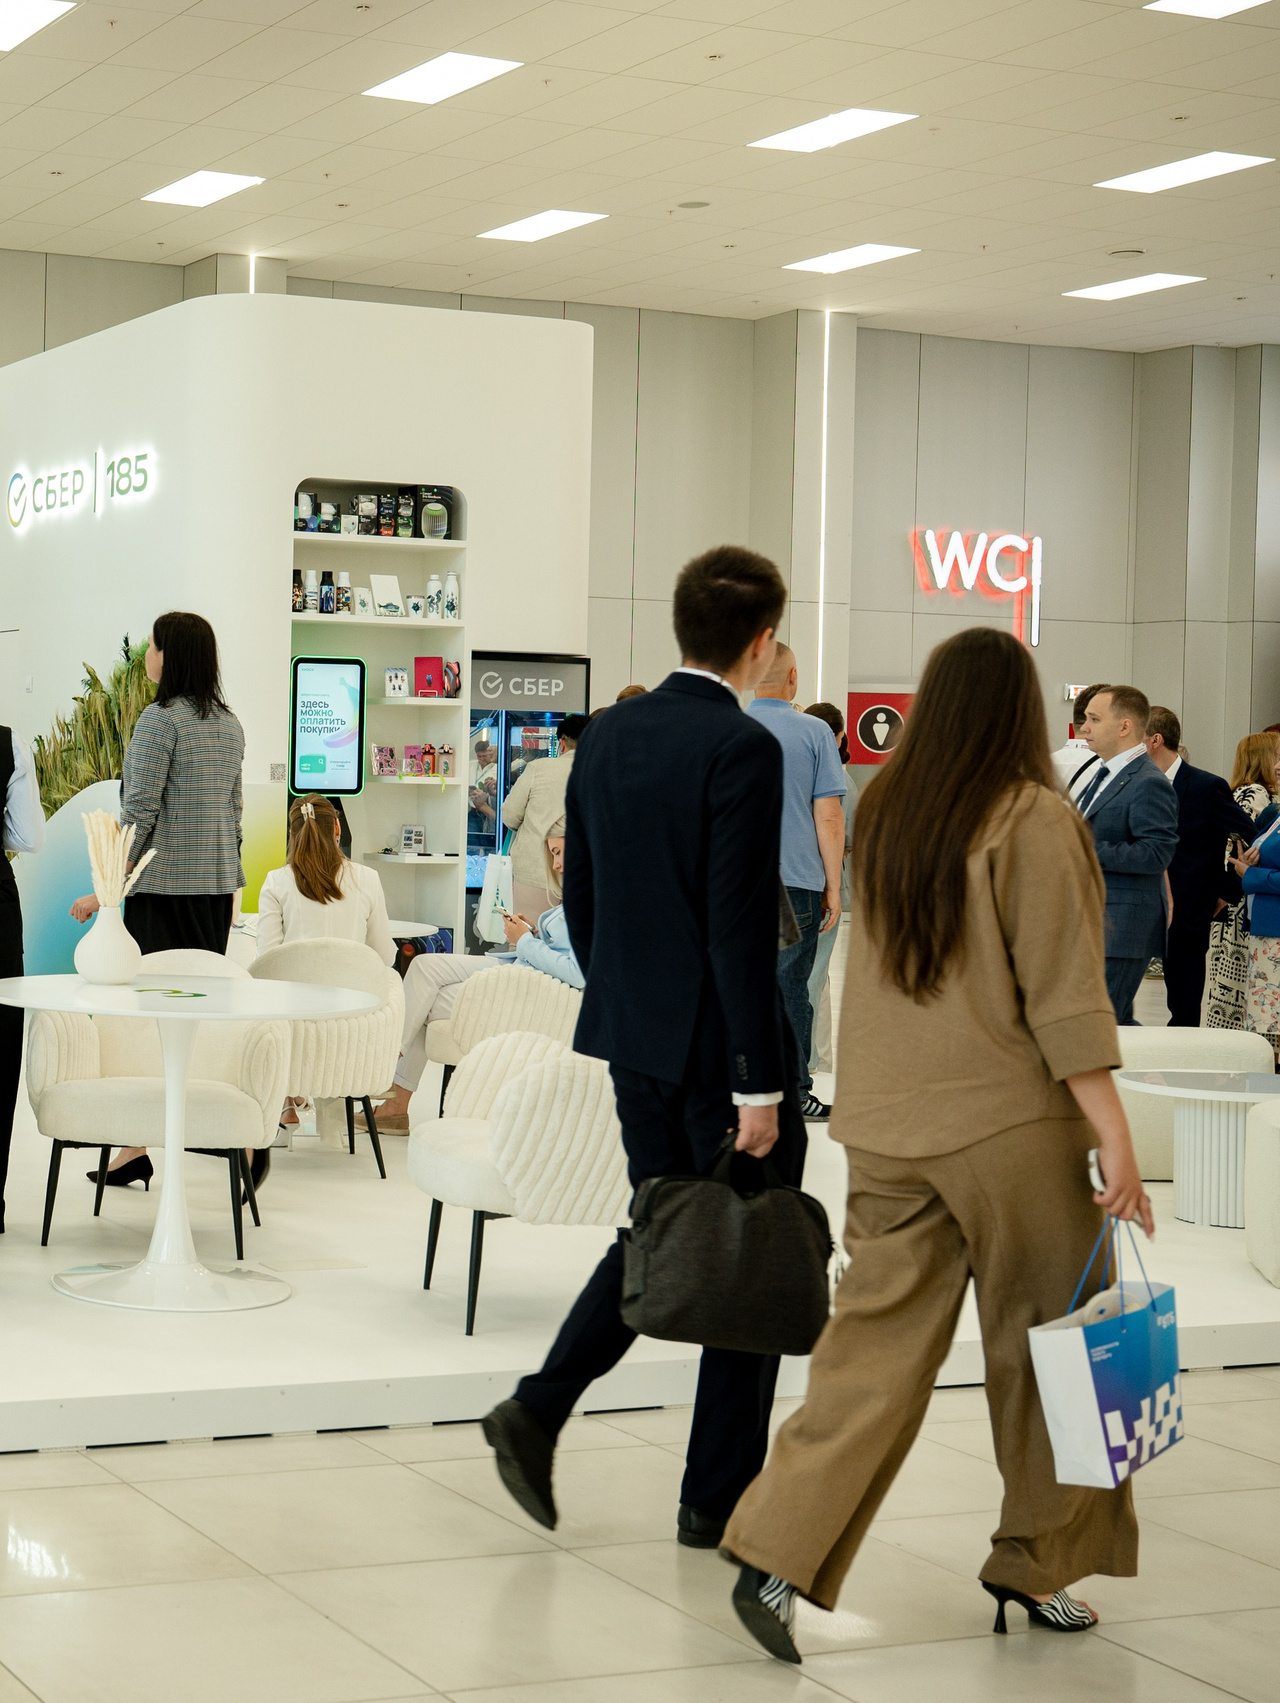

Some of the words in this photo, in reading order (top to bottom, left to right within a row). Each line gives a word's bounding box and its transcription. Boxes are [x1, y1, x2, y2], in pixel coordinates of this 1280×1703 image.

[32, 469, 84, 513] СБЕР
[106, 453, 148, 498] 185
[924, 529, 1029, 593] WC
[508, 676, 564, 696] СБЕР
[300, 700, 329, 709] здесь
[300, 709, 334, 717] можно
[300, 717, 347, 726] оплатить
